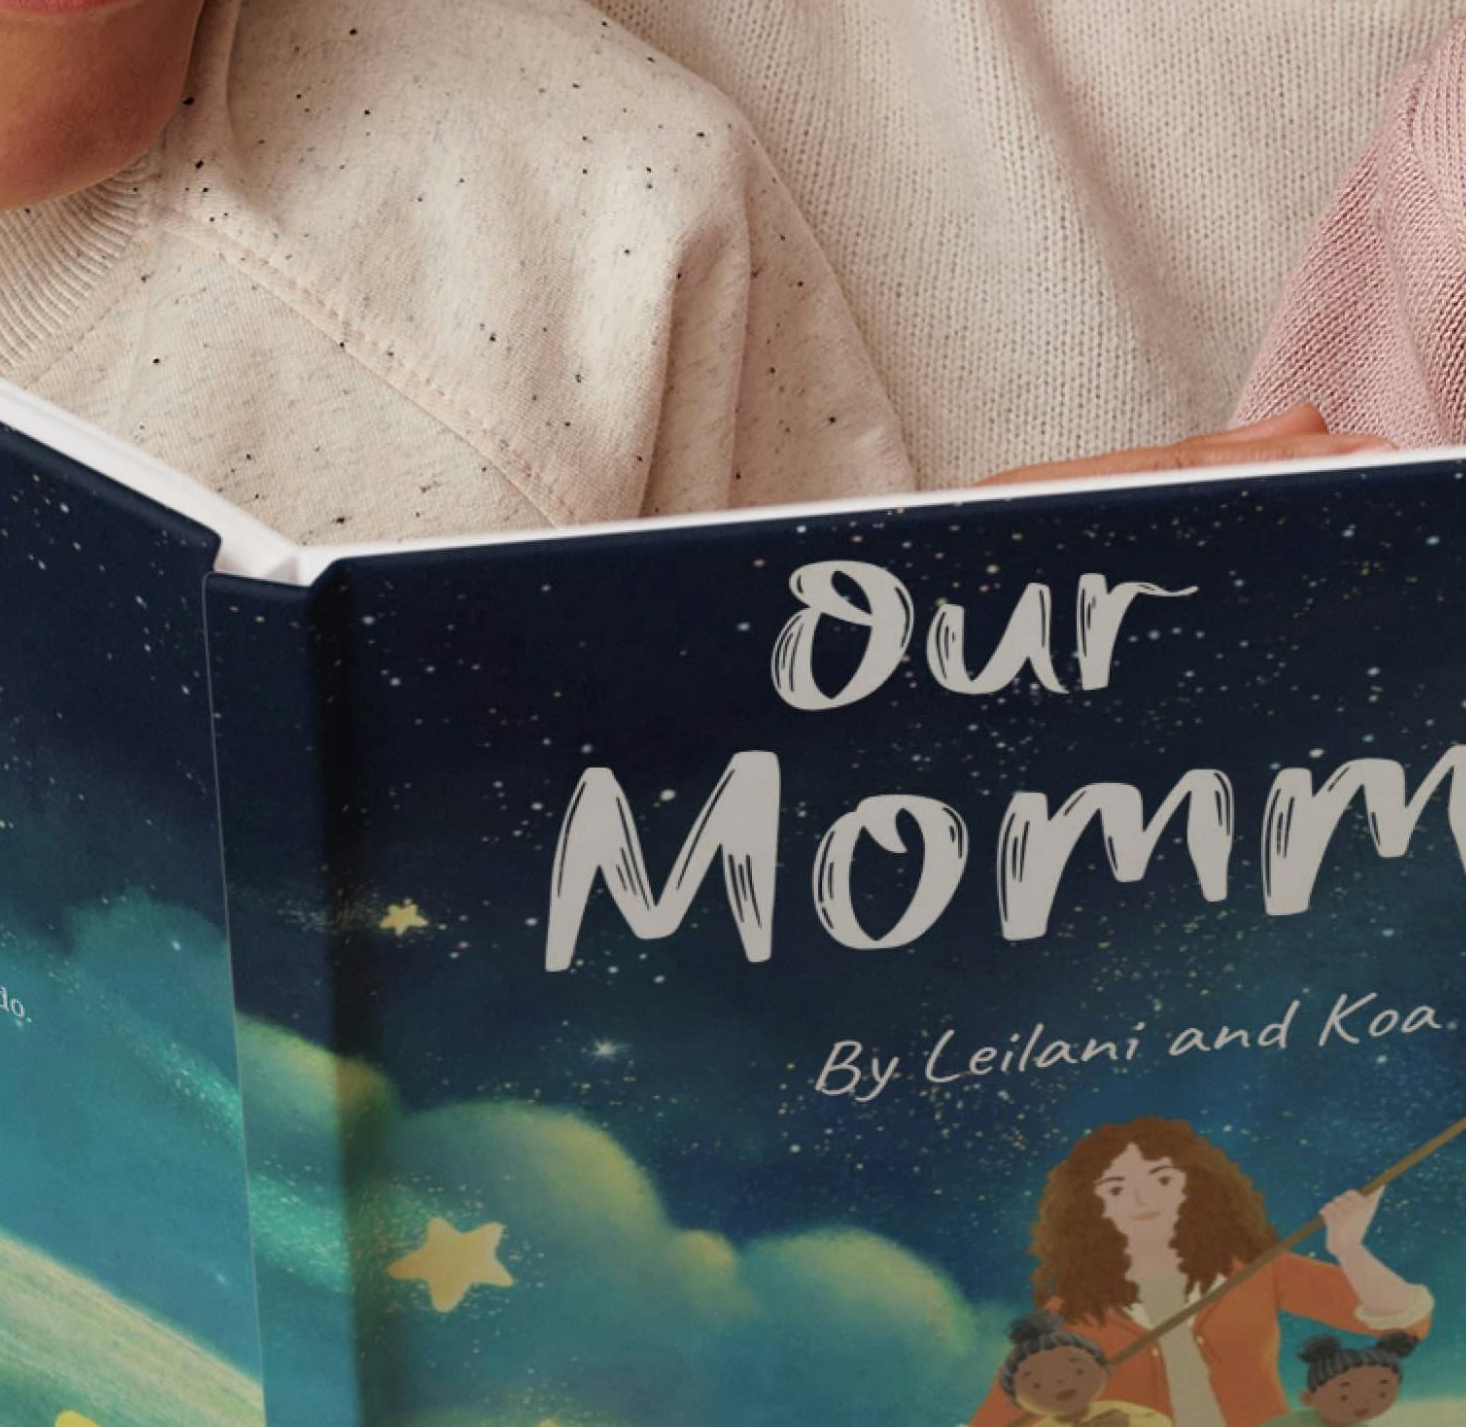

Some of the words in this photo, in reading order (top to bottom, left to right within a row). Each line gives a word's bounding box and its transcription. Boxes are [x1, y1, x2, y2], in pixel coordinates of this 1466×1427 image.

[814, 1040, 900, 1103] By
[924, 1021, 1146, 1084] Leilani
[1168, 999, 1301, 1059] and
[1318, 992, 1442, 1047] Koa
